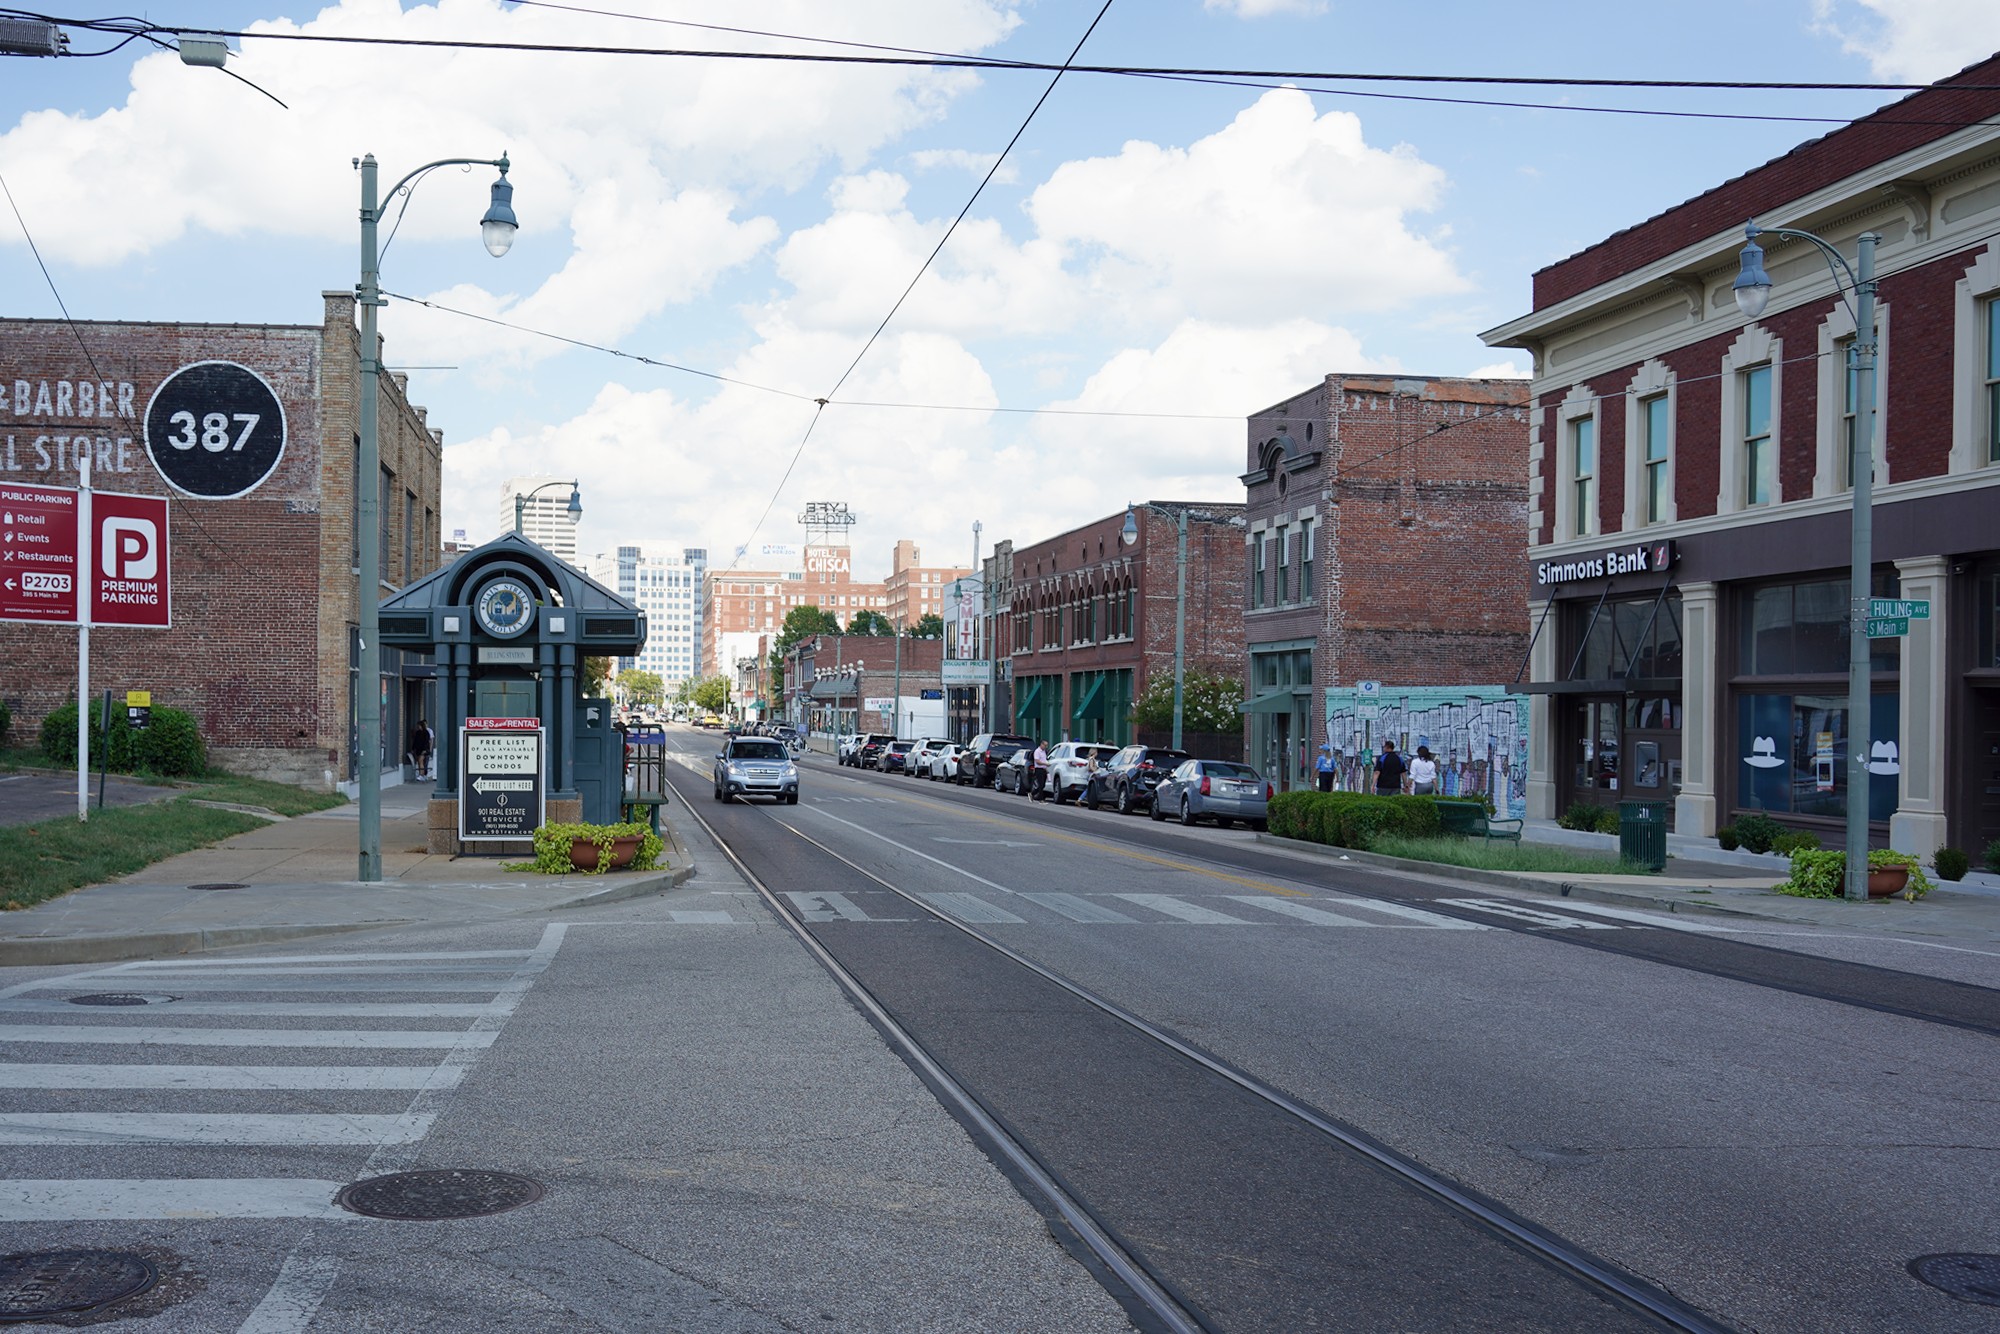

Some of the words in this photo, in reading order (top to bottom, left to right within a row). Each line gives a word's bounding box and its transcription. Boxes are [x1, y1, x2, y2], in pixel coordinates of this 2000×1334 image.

[14, 379, 137, 418] BARBER
[167, 410, 261, 453] 387
[34, 435, 133, 472] STORE
[1, 491, 33, 502] PUBLIC
[34, 494, 73, 505] PARKING
[17, 514, 45, 525] Retail
[17, 532, 50, 543] Events
[17, 551, 74, 563] Restaurants
[807, 548, 832, 558] HOTEL
[807, 558, 850, 573] CHISCA
[1538, 559, 1603, 585] Simmons
[1607, 546, 1648, 575] Bank
[24, 575, 69, 589] P2703
[101, 580, 158, 593] PREMIUM
[101, 592, 158, 605] PARKING
[481, 586, 499, 604] MAIN
[504, 585, 529, 604] STREET
[1874, 602, 1913, 617] HULING
[1914, 605, 1928, 614] AVE
[486, 620, 524, 633] TROLLEY
[961, 593, 973, 657] SMITH
[1869, 622, 1875, 635] S
[1876, 620, 1897, 635] Main
[1899, 622, 1906, 631] ST
[468, 720, 494, 728] SALES
[507, 720, 537, 728] RENTAL
[478, 808, 488, 816] 901
[489, 808, 504, 816] REAL
[505, 808, 526, 816] ESTATE
